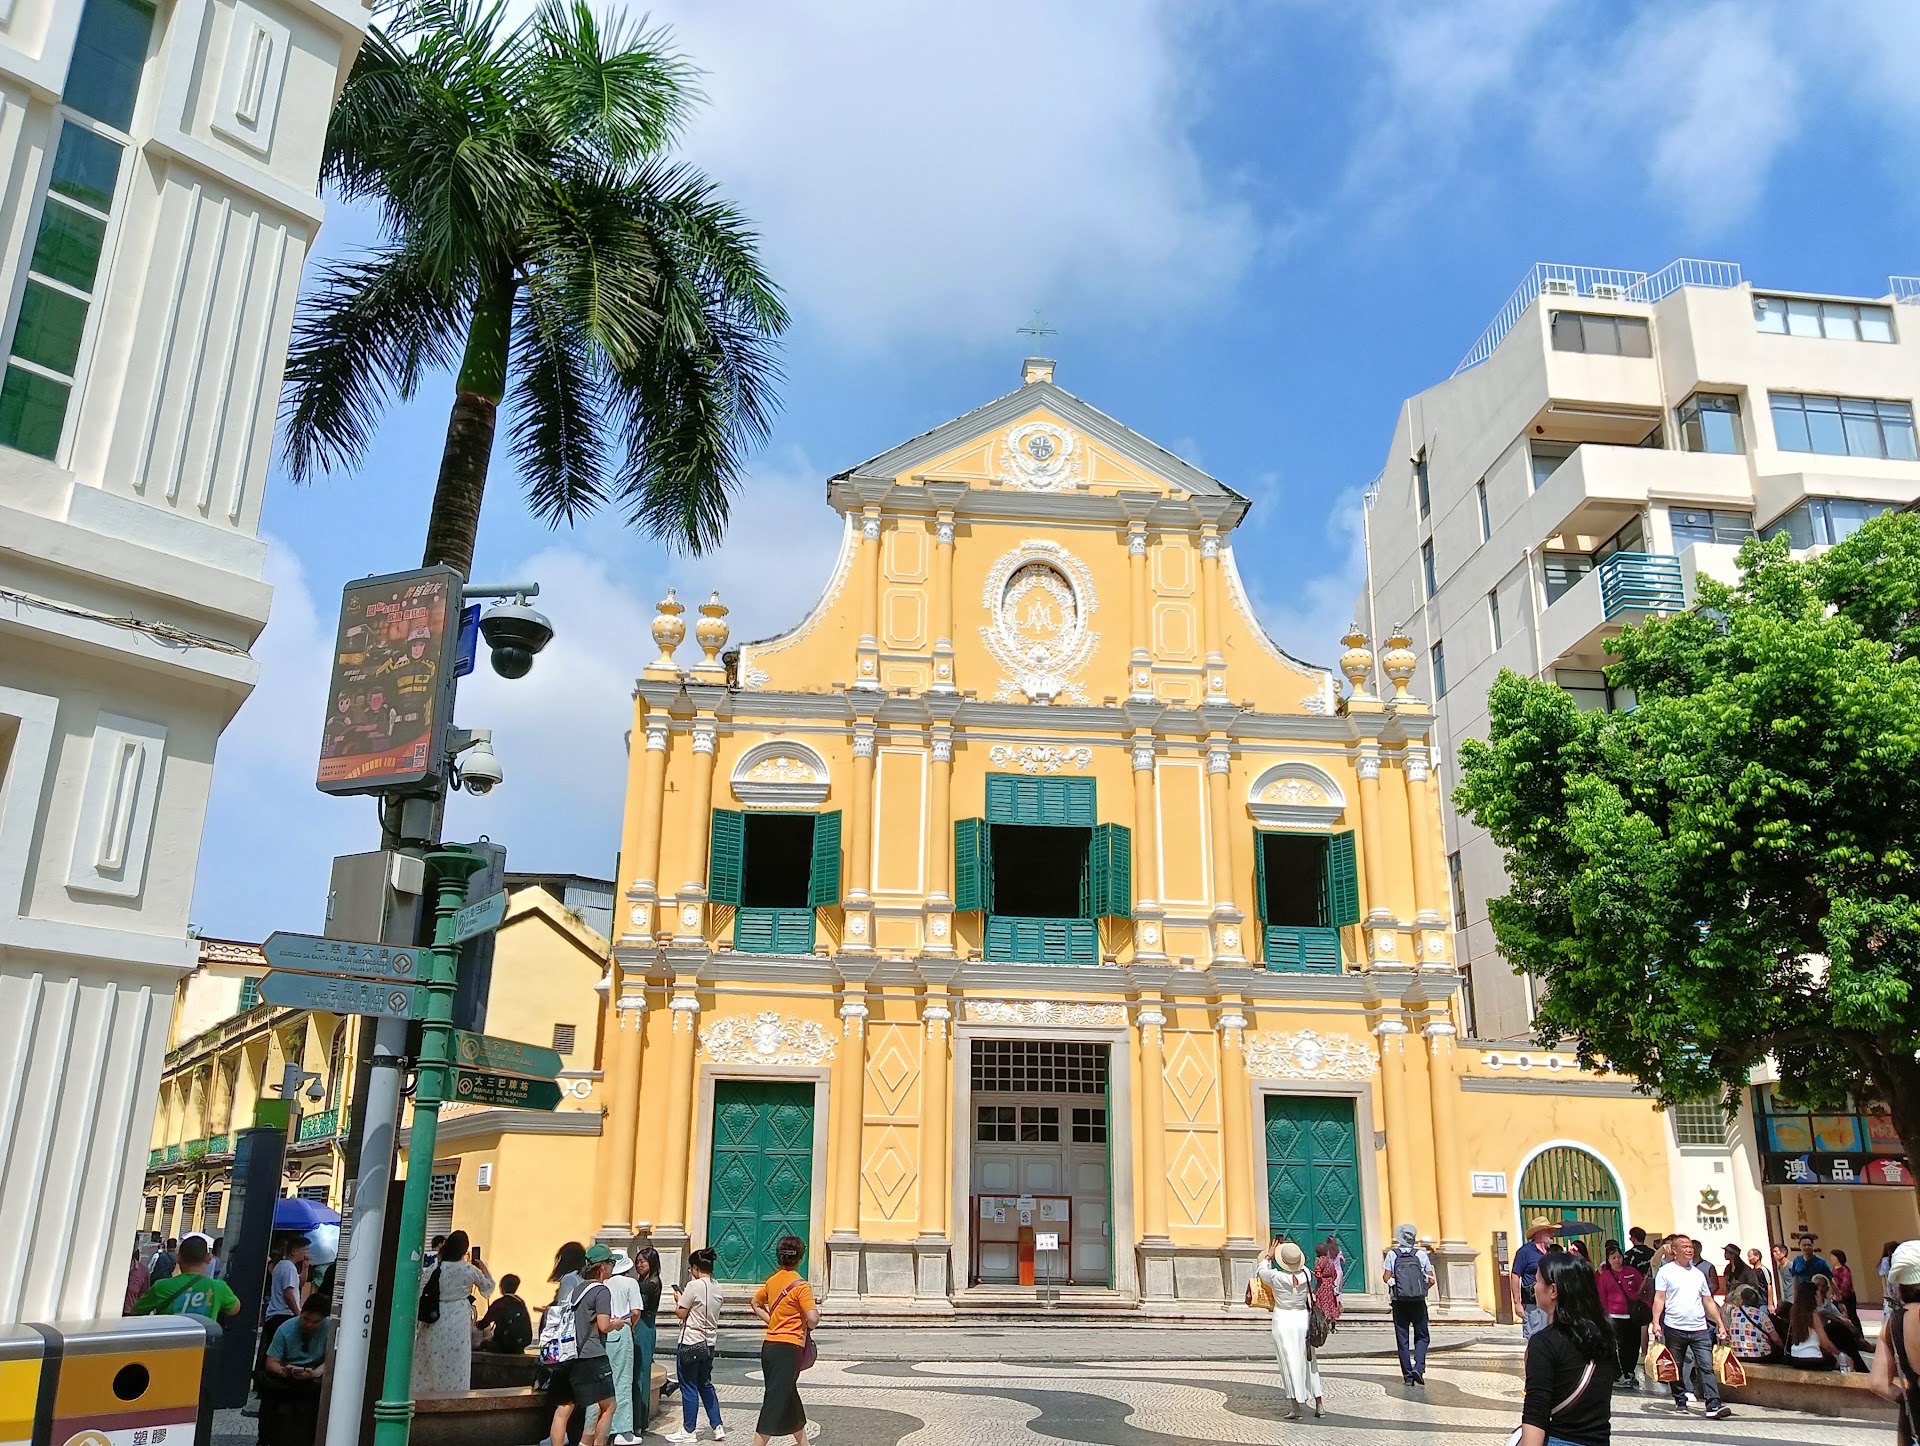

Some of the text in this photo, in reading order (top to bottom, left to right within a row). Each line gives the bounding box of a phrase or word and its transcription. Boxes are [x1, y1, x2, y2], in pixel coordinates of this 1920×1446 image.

[474, 1076, 530, 1092] 大三巴牌坊
[1784, 1158, 1903, 1183] 澳品薈
[181, 1287, 214, 1315] jet
